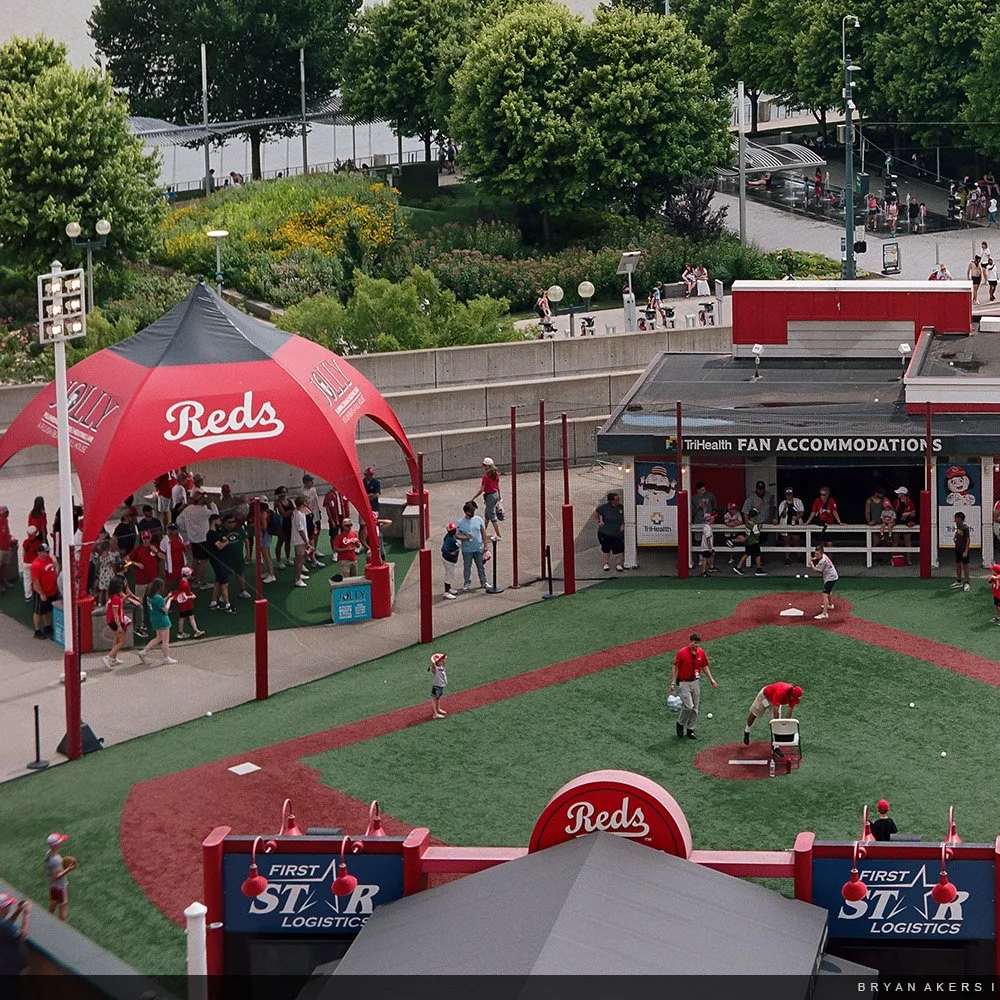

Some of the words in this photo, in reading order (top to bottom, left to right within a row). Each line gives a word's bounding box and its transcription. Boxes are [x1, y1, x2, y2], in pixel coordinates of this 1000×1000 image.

[163, 390, 285, 453] Reds
[684, 439, 732, 451] TriHealth
[737, 438, 771, 451] FAN
[775, 438, 943, 452] ACCOMMODATIONS
[564, 796, 650, 838] Reds
[268, 864, 320, 876] FIRST
[859, 870, 910, 882] FIRST
[870, 922, 961, 934] LOGISTICS
